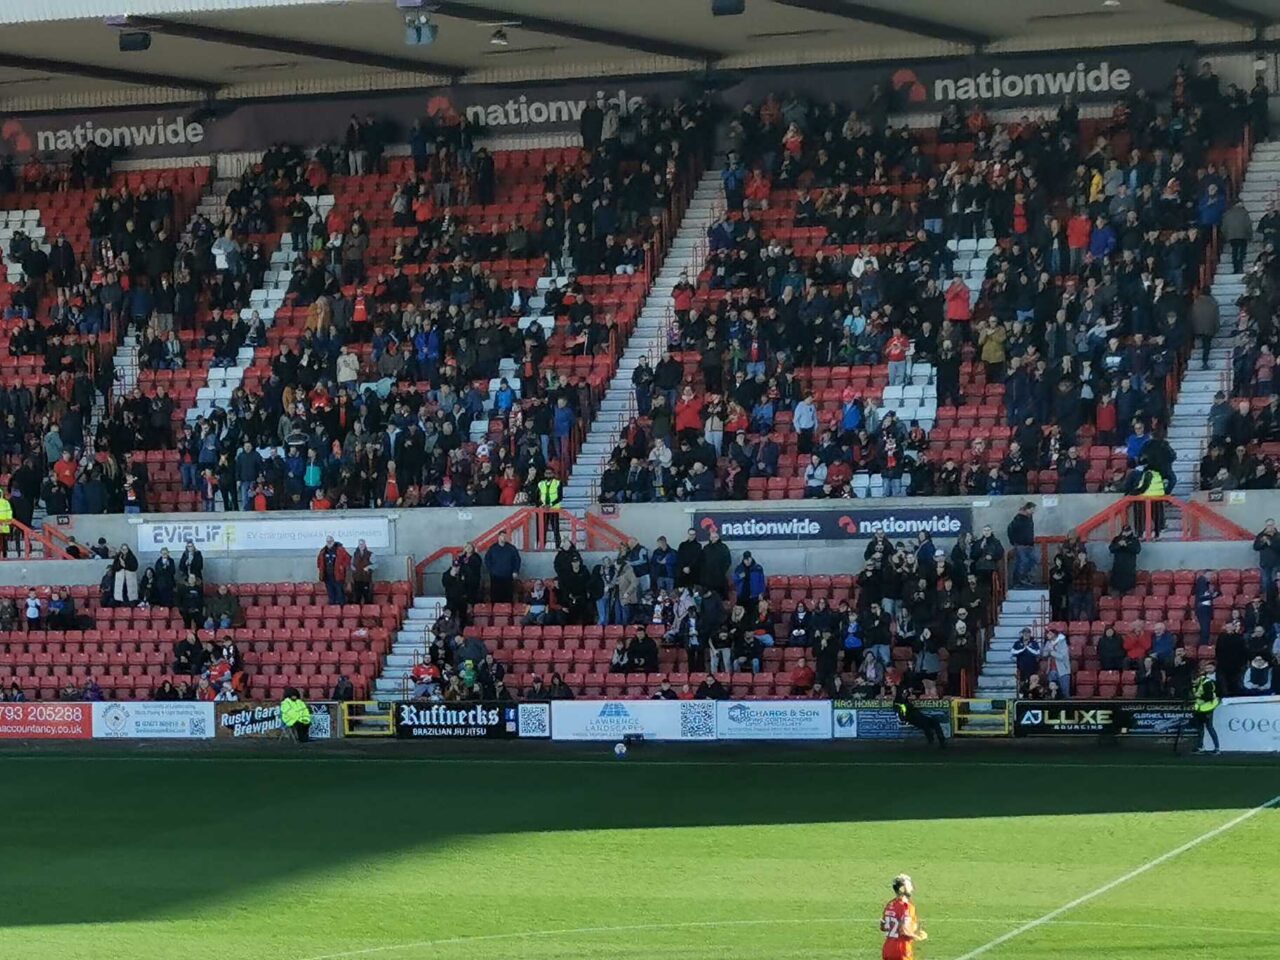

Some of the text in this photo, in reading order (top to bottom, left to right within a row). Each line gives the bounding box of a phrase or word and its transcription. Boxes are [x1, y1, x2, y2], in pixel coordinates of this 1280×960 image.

[934, 62, 1131, 101] nationwide
[37, 117, 204, 151] nationwide
[721, 518, 820, 535] nationwide
[859, 515, 962, 533] nationwide
[854, 700, 881, 708] HOME
[27, 706, 83, 721] 205288
[220, 709, 253, 727] Rusty
[589, 718, 641, 726] LAWRENCE
[1044, 709, 1114, 725] LUXE
[233, 716, 282, 738] Brewpub
[412, 727, 487, 736] BRAZILIAN JIU JITSU
